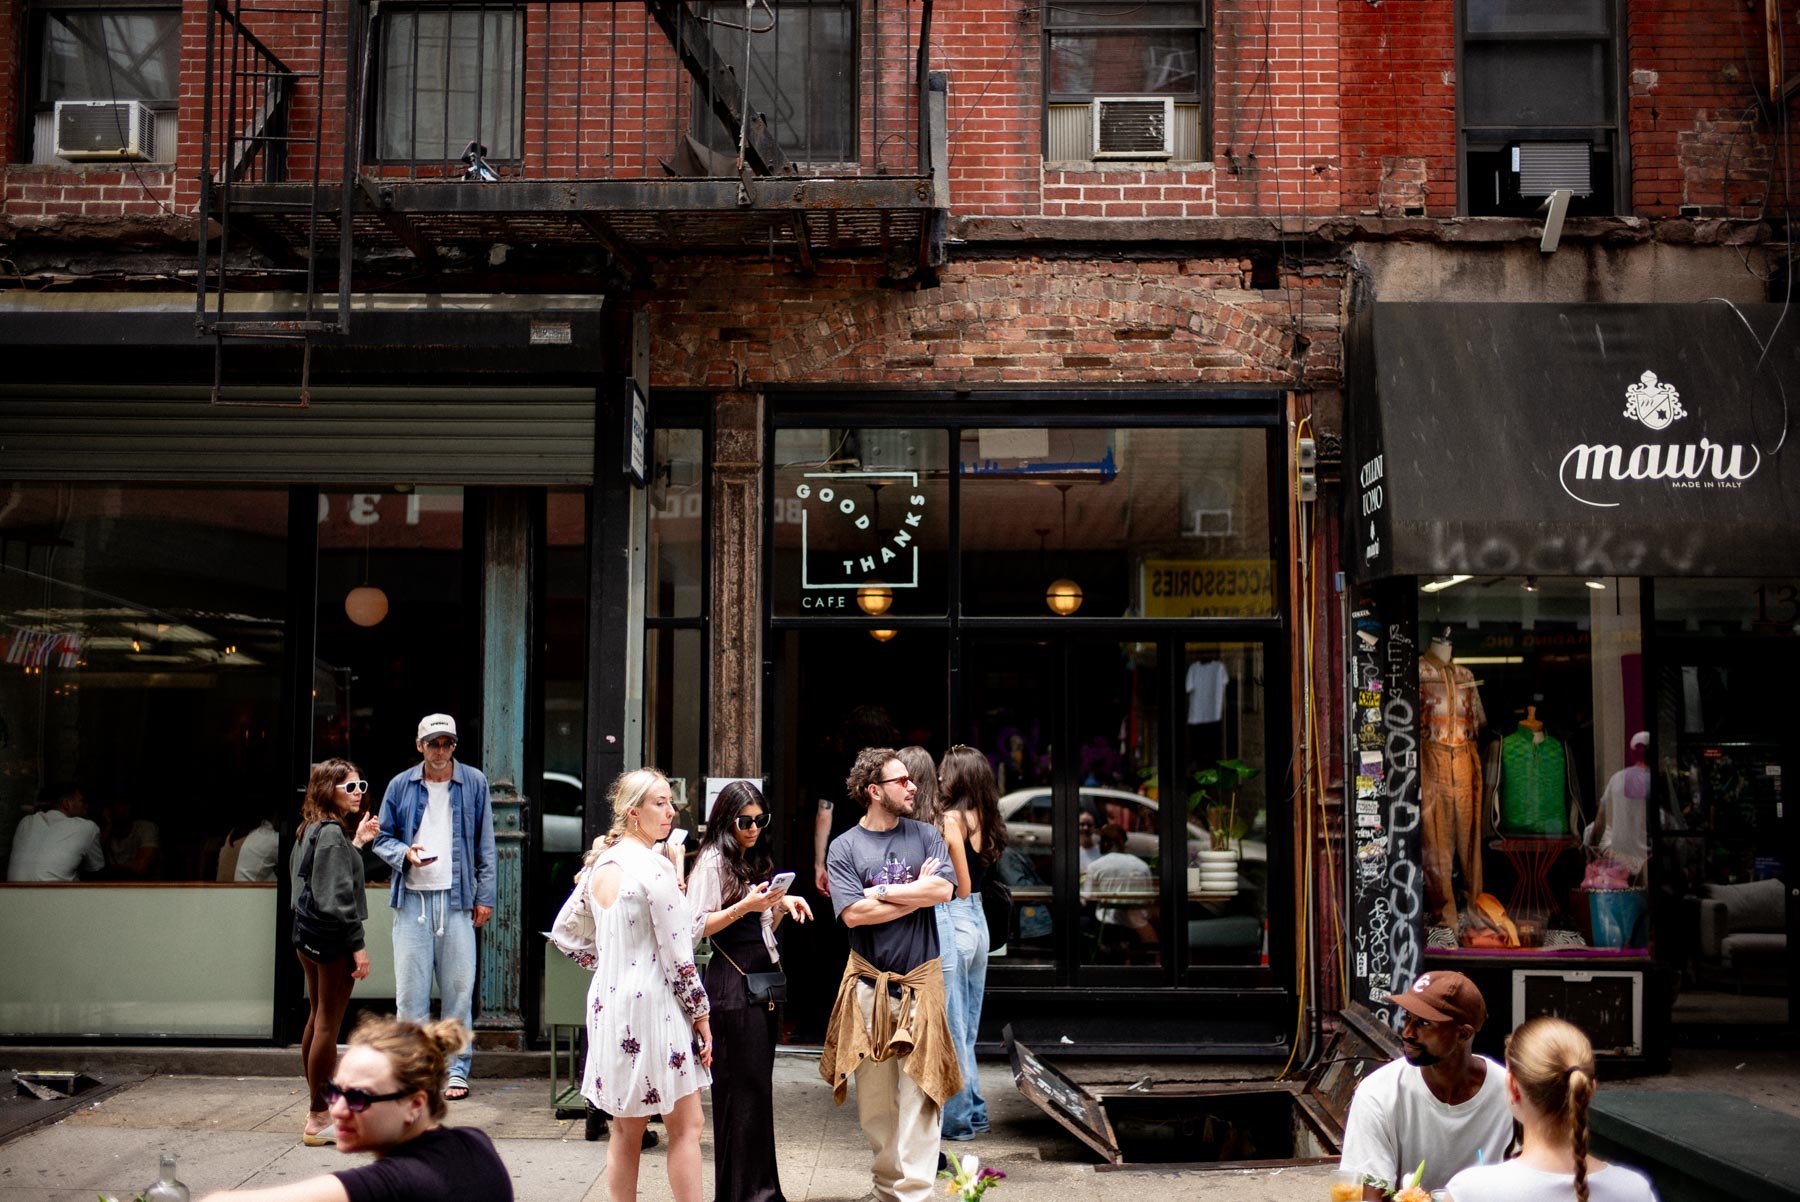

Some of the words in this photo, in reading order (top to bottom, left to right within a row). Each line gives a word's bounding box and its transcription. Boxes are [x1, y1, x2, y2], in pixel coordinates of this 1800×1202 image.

[796, 484, 870, 530] GOOD
[843, 495, 925, 574] THANKS
[802, 597, 845, 608] CAFE
